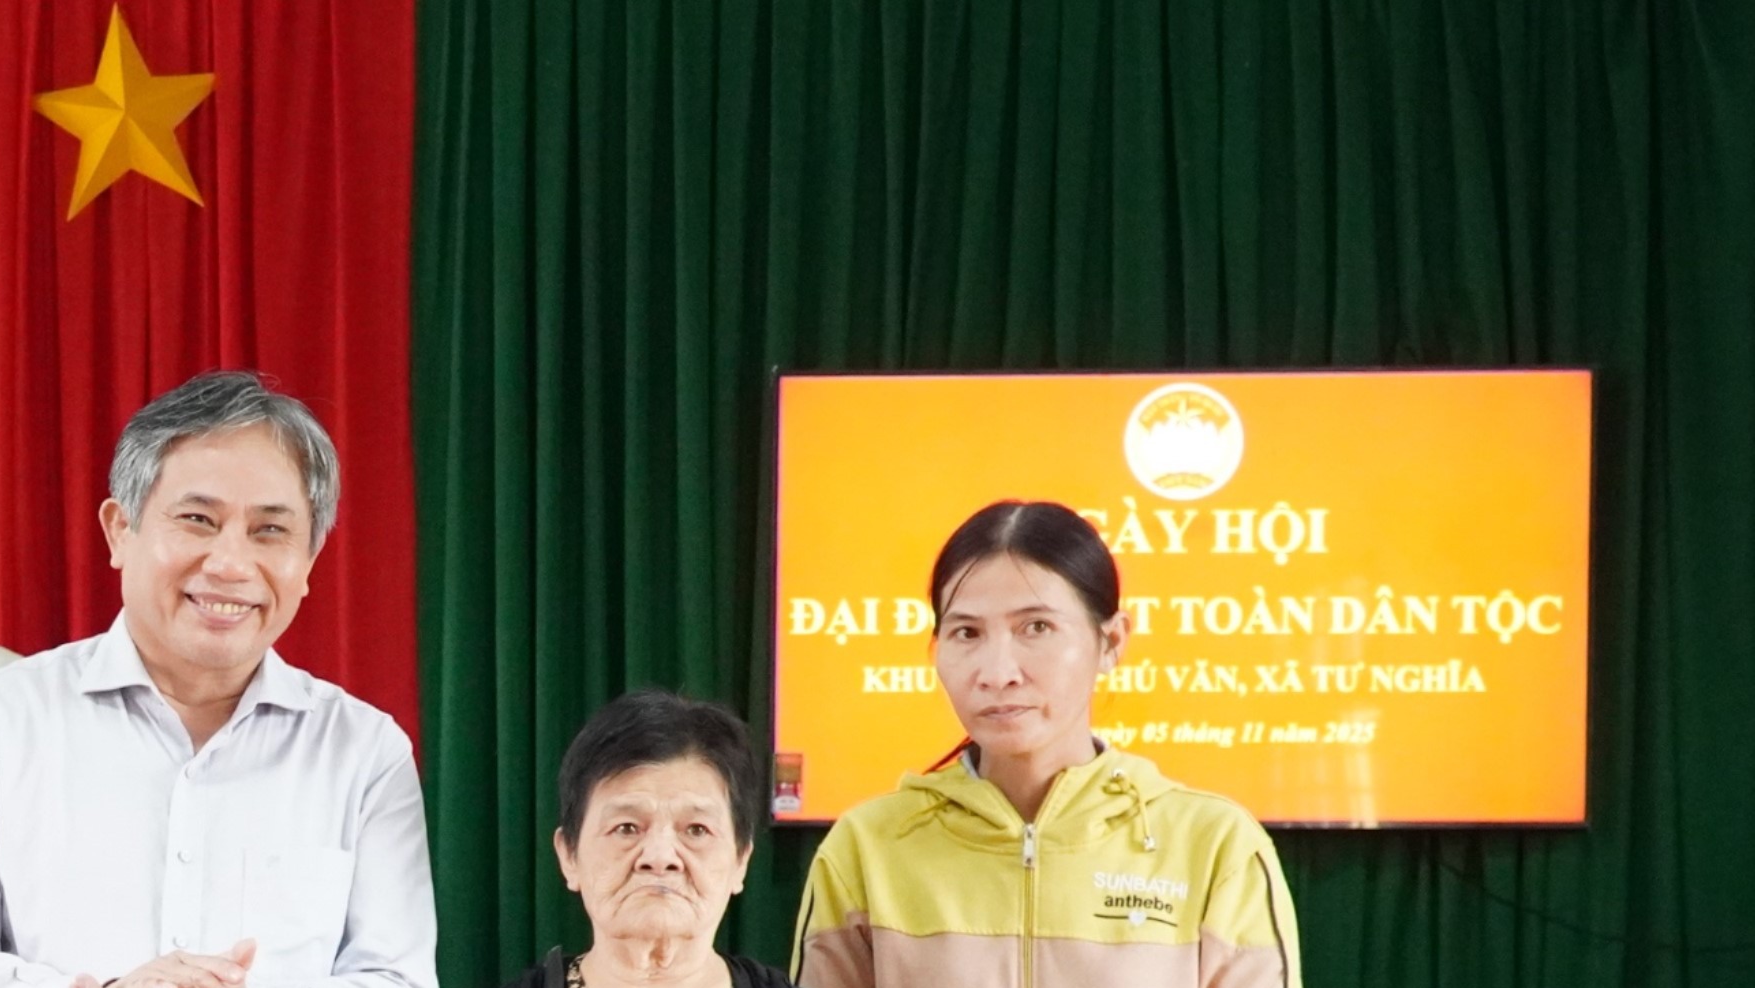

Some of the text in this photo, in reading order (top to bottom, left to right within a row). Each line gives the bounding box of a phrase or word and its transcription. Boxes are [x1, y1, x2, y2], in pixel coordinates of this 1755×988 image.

[1076, 494, 1329, 565] ÀY HỘI
[789, 597, 880, 645] ĐẠI
[1170, 585, 1315, 635] TOÀN
[1328, 584, 1440, 635] DÂN
[1451, 589, 1563, 645] TỘC
[861, 665, 938, 693] KHU
[1165, 659, 1247, 697] VĂN,
[1254, 659, 1304, 693] XÃ
[1311, 661, 1365, 693] TƯ
[1369, 659, 1486, 693] NGHĨA
[1142, 721, 1169, 743] 05
[1172, 721, 1236, 748] tháng
[1241, 721, 1266, 743] 11
[1270, 721, 1317, 743] năm
[1323, 721, 1376, 744] 2025
